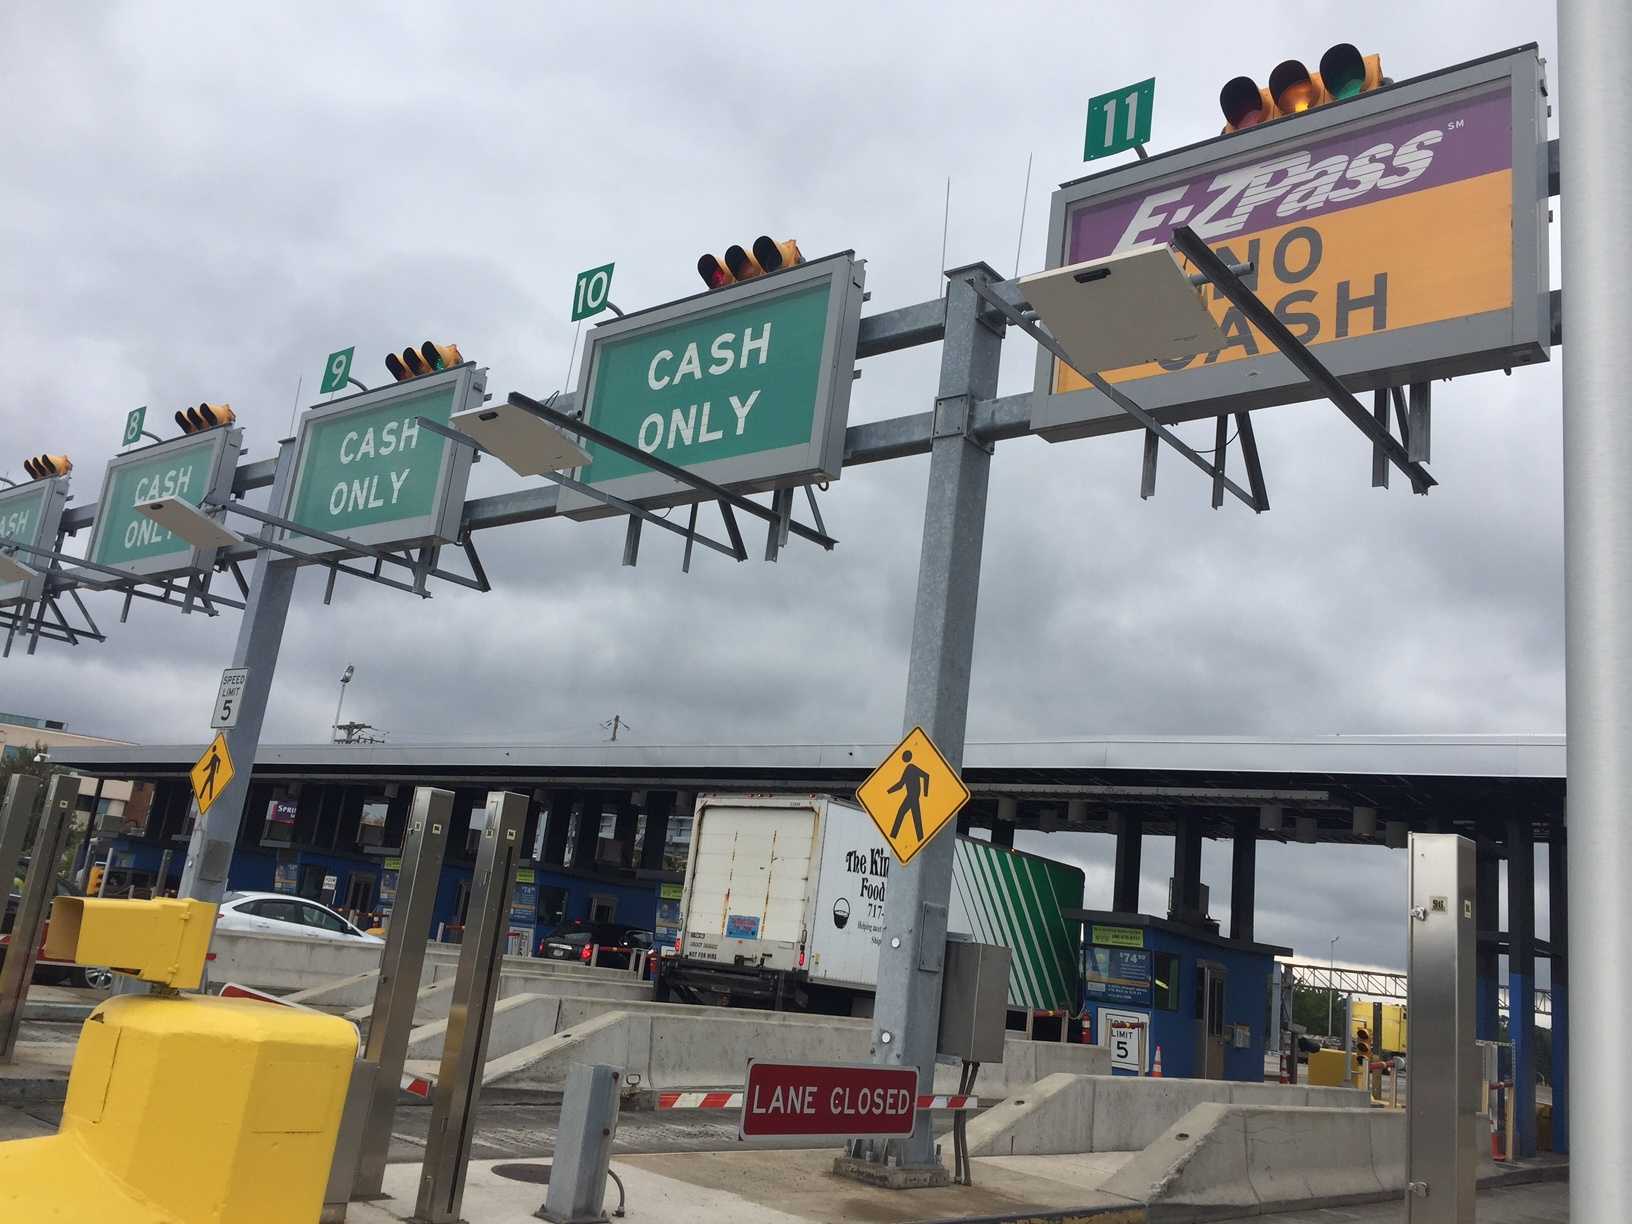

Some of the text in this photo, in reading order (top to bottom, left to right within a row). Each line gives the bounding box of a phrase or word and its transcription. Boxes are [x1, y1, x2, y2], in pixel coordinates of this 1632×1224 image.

[1103, 91, 1138, 148] 11
[1111, 129, 1444, 256] E-ZPass
[1212, 226, 1324, 302] NO
[577, 271, 608, 314] 10
[331, 354, 347, 388] 9
[648, 322, 772, 390] CASH
[126, 411, 140, 440] 8
[638, 390, 761, 453] ONLY
[340, 418, 420, 464] CASH
[135, 465, 193, 502] CASH
[329, 468, 411, 515] ONLY
[124, 519, 172, 549] ONL
[222, 687, 240, 697] LIMIT
[223, 675, 246, 685] SPEED
[221, 700, 232, 720] 5
[846, 850, 867, 874] The
[860, 877, 886, 902] Food
[1111, 1030, 1133, 1039] LIMIT
[1117, 1041, 1128, 1058] 5
[752, 1085, 910, 1115] LANE CLOSED
